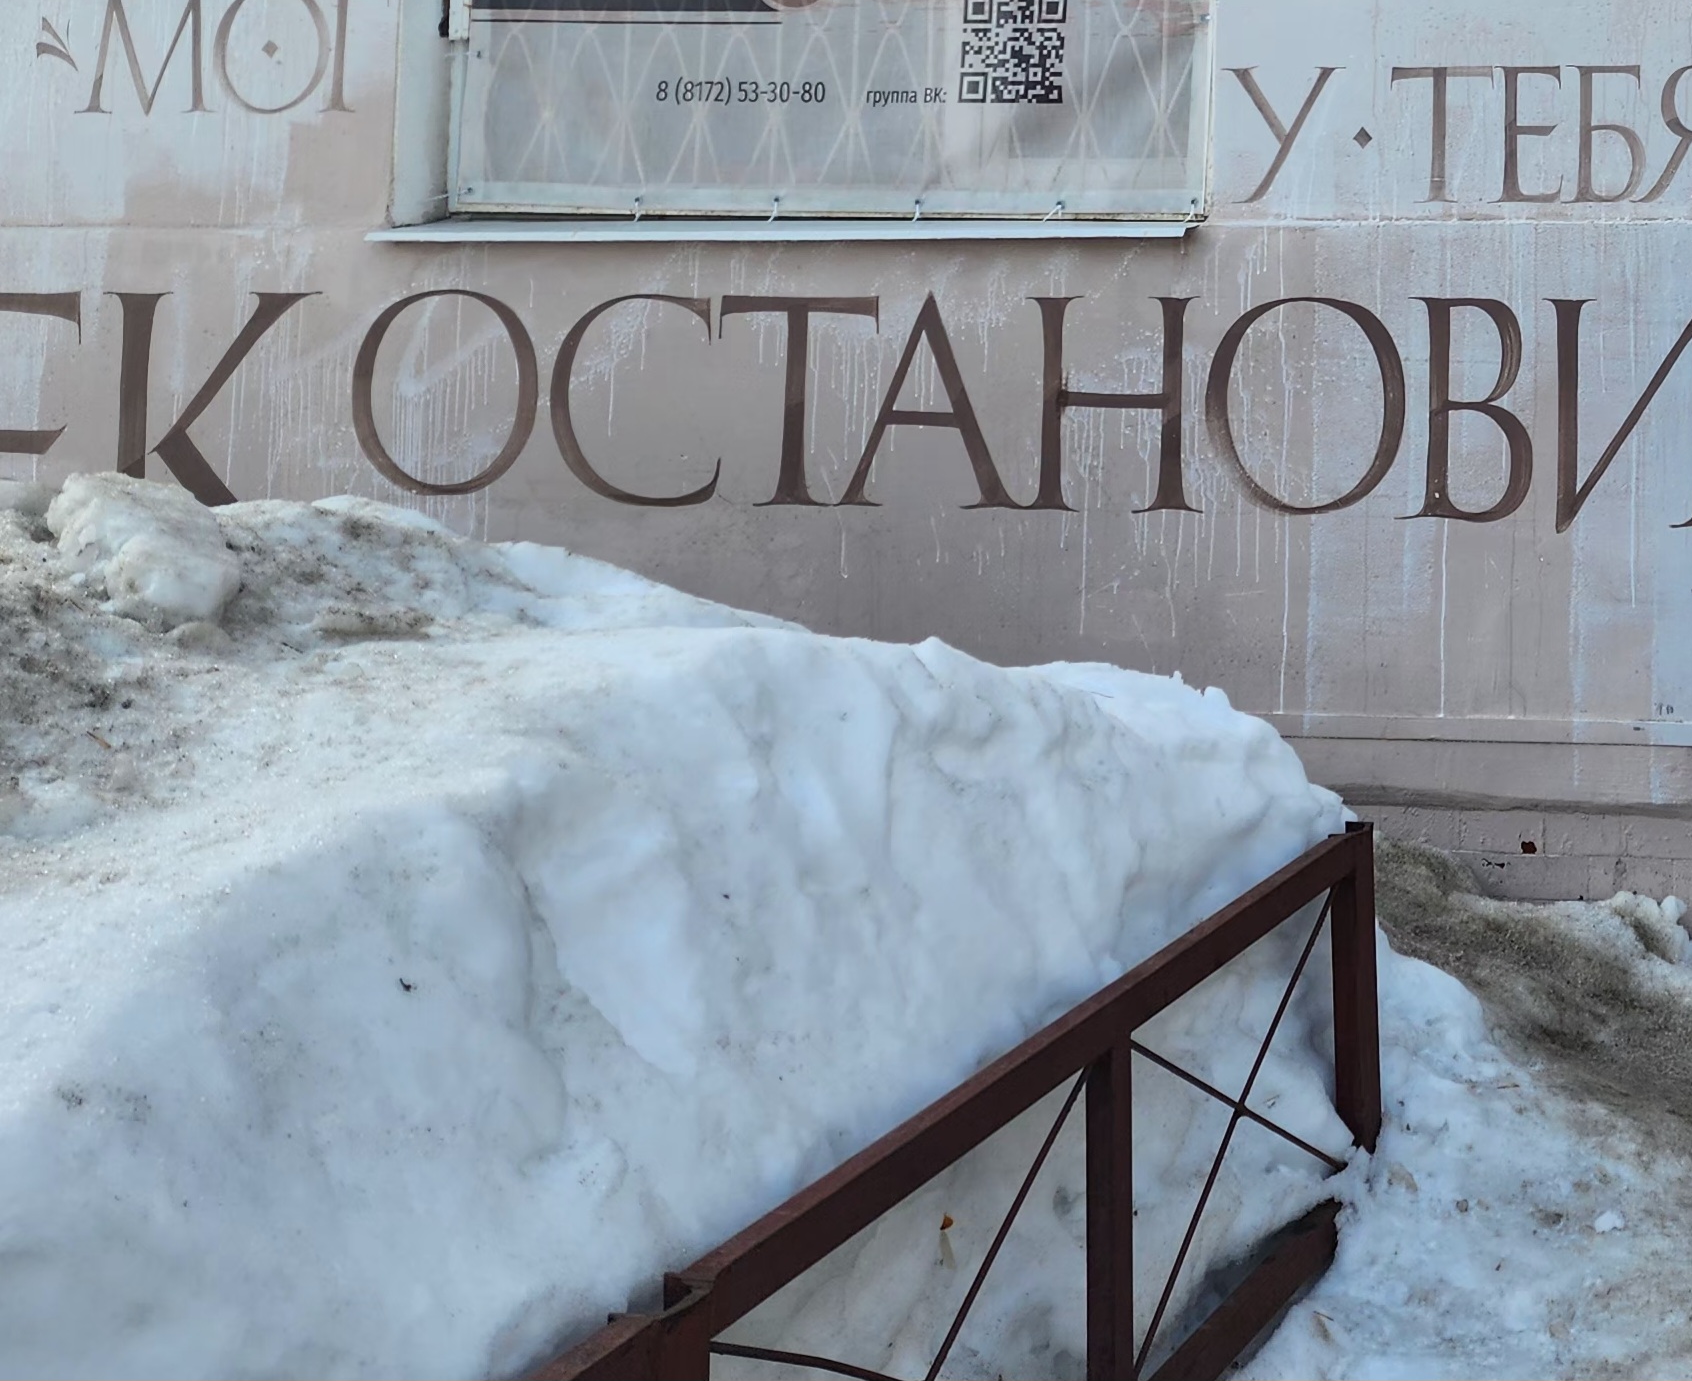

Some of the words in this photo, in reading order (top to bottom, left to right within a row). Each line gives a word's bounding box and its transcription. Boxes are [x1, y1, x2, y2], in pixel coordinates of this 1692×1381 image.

[656, 81, 668, 103] 8
[675, 76, 731, 106] (8172)
[737, 81, 826, 103] 53-30-80
[866, 89, 917, 108] группа
[924, 88, 947, 104] ВК:
[1222, 65, 1347, 204] У
